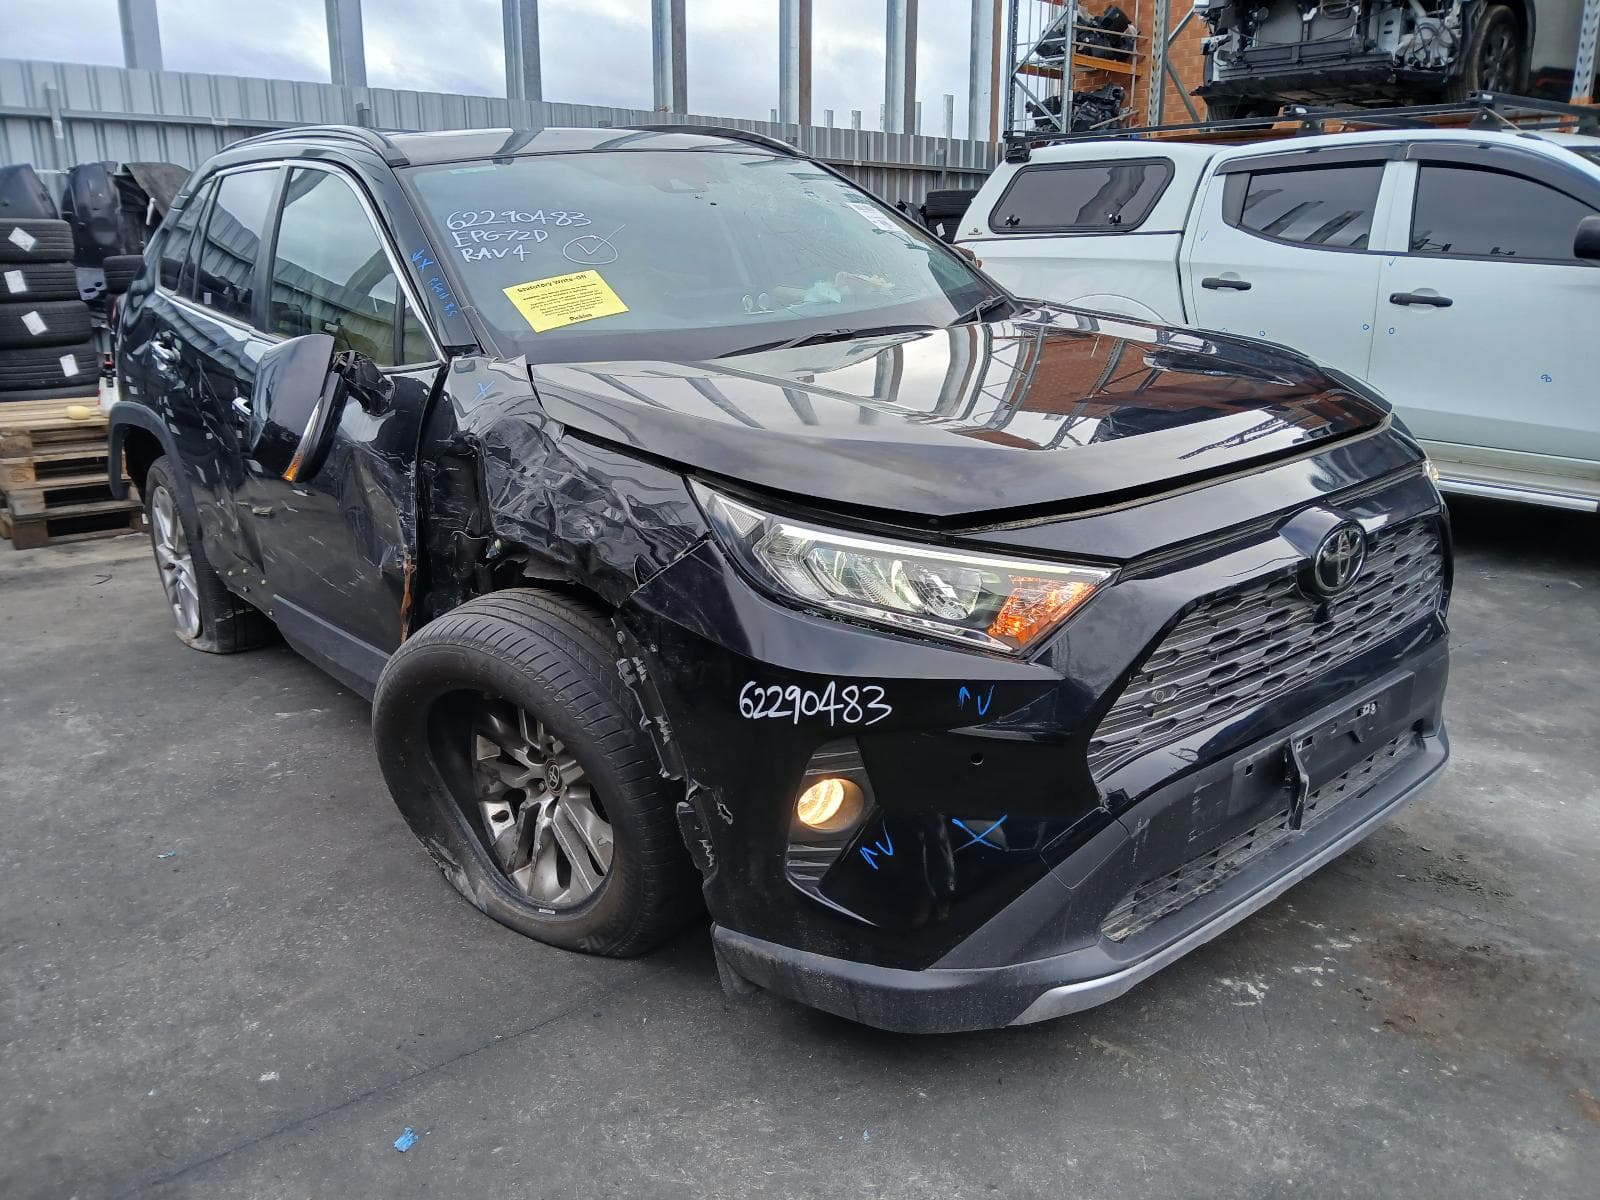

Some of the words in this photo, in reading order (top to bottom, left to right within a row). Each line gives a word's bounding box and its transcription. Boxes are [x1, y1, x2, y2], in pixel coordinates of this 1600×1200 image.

[446, 209, 592, 230] 62290483
[517, 279, 552, 292] Statutory
[739, 680, 893, 727] 62290483
